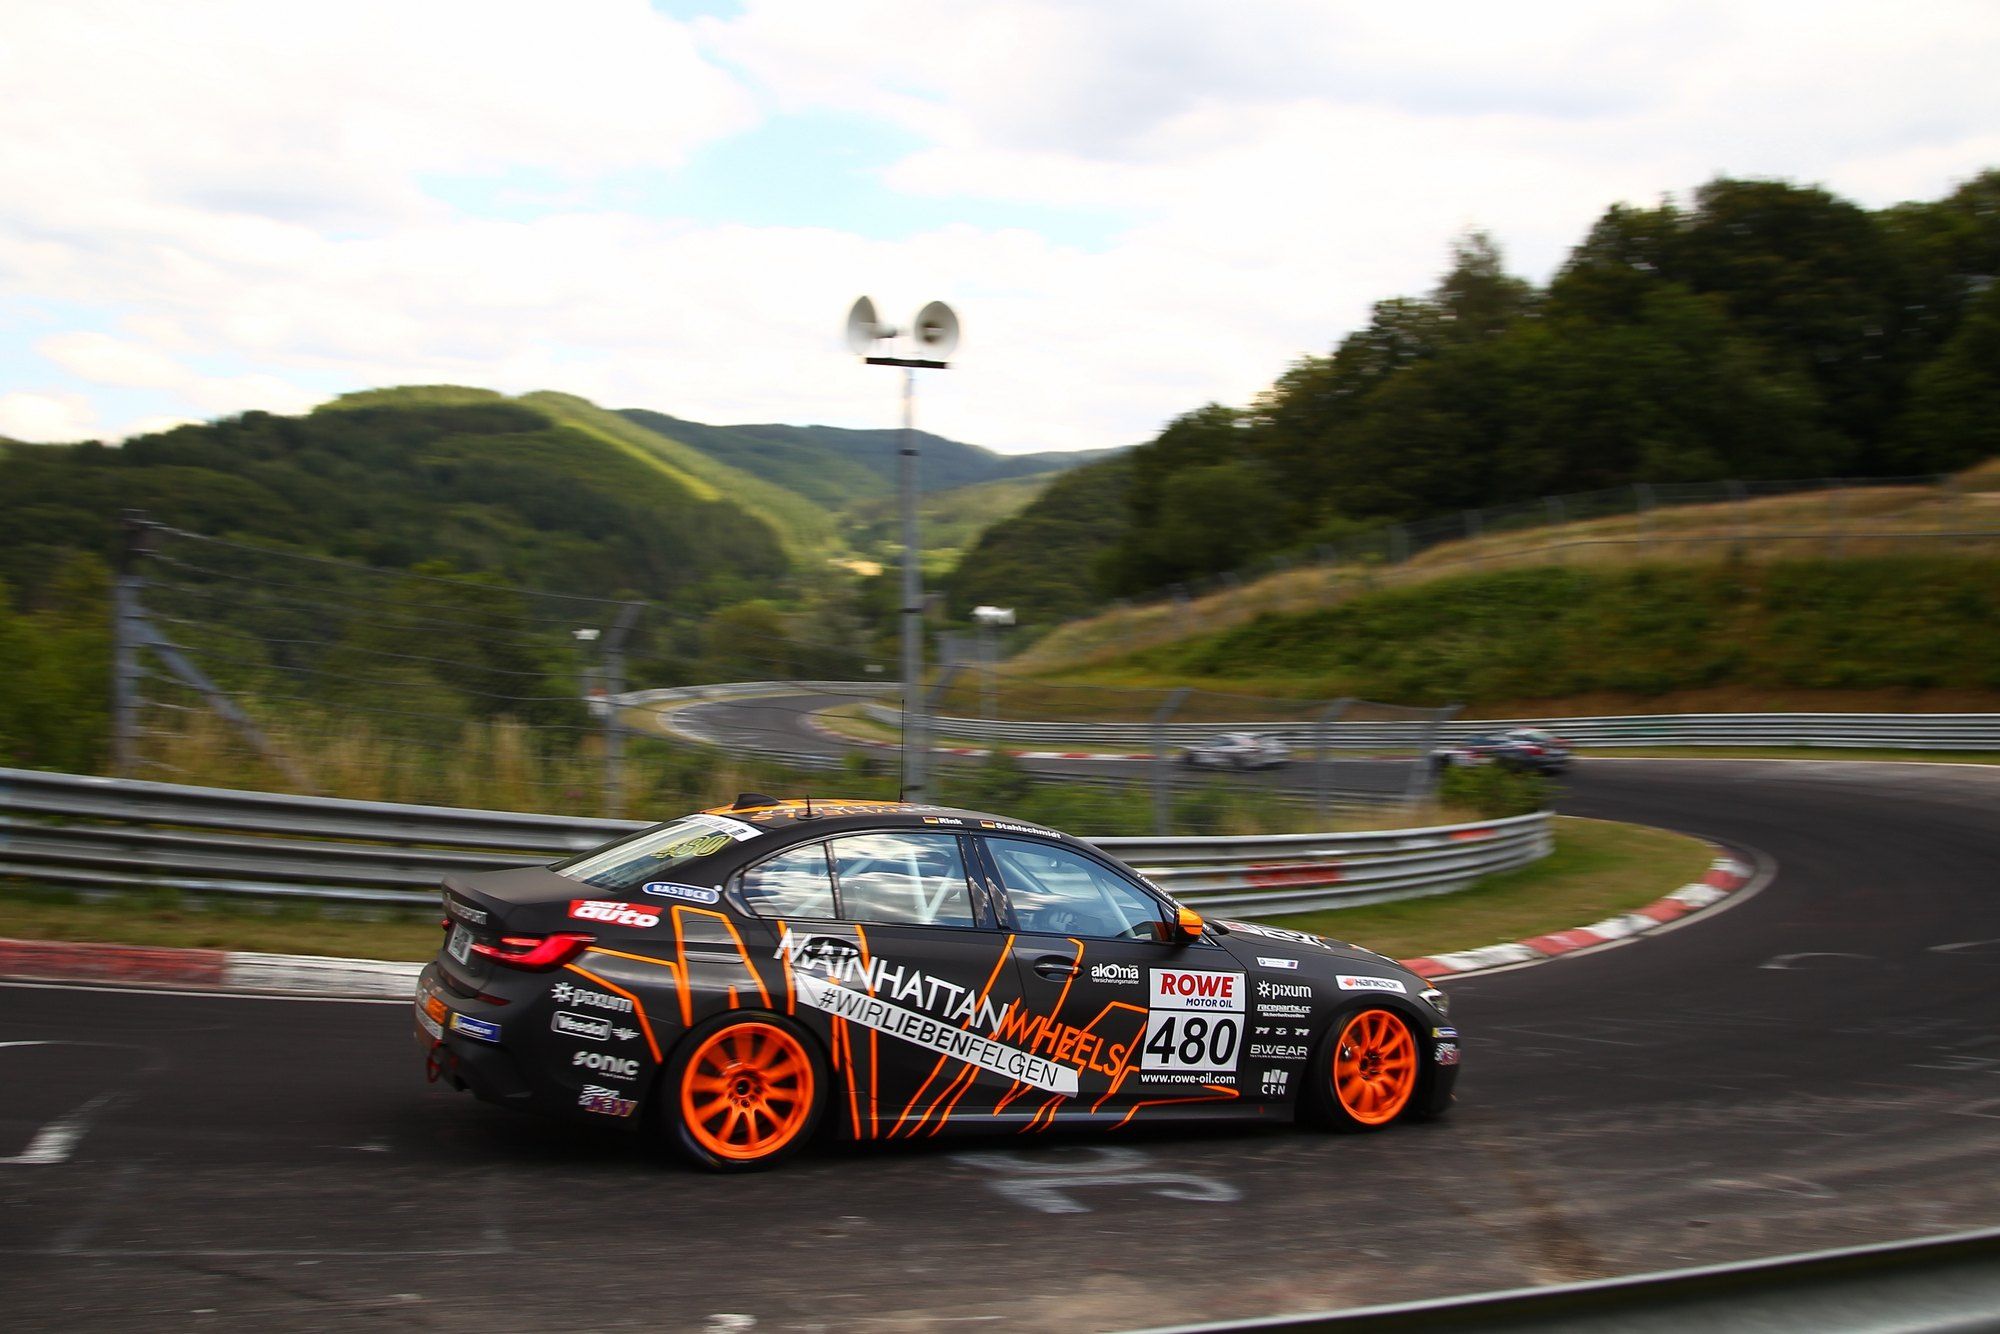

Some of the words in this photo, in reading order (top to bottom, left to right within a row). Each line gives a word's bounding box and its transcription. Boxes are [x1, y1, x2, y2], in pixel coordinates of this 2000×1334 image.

[938, 817, 963, 825] Rink
[995, 822, 1062, 840] Stahlschmidt
[573, 906, 660, 927] auto
[1160, 973, 1234, 998] ROWE
[1272, 984, 1312, 999] pixum
[1185, 998, 1217, 1008] MOTOR
[1219, 1000, 1233, 1008] OIL
[818, 987, 1059, 1089] #WIRLIEBENFELGEN
[1145, 1016, 1238, 1066] 480
[1250, 1044, 1308, 1056] BWEAR
[1141, 1072, 1236, 1084] www.rowe-oil.com
[1261, 1084, 1286, 1095] CFN
